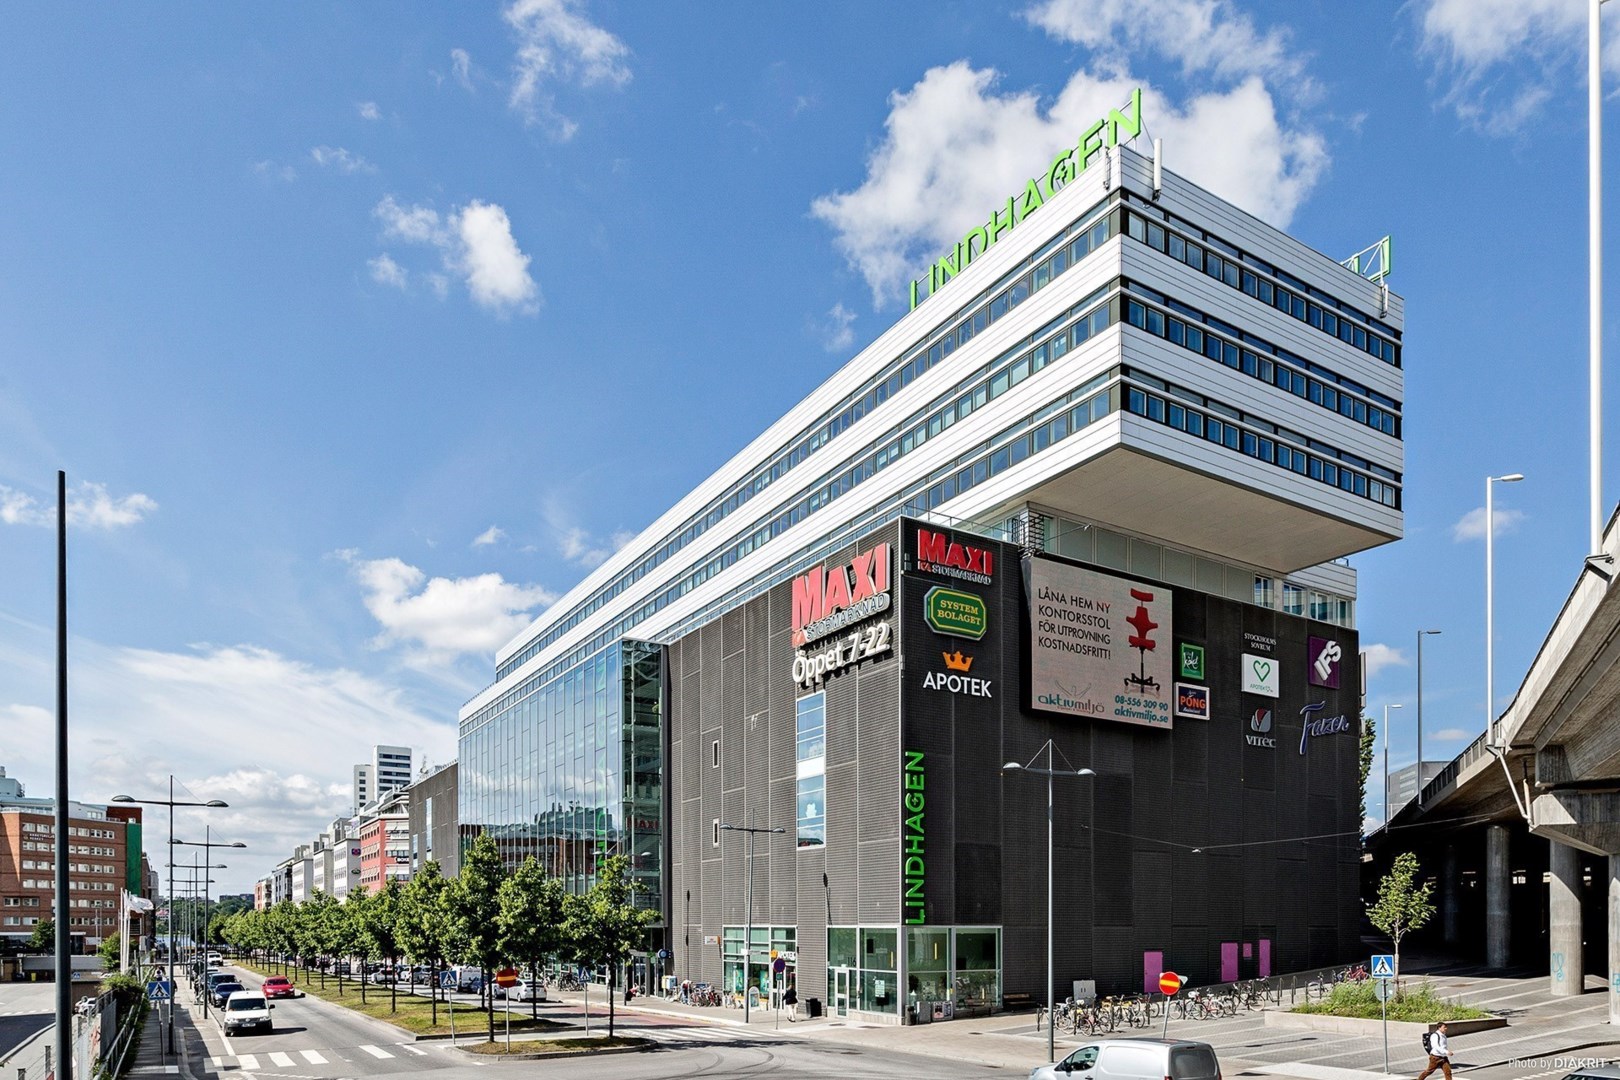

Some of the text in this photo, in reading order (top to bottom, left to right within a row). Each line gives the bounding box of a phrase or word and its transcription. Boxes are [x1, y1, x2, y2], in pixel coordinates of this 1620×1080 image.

[910, 87, 1142, 311] LINDHAGEN
[917, 528, 993, 576] MAXI
[792, 542, 891, 631] MAXI
[931, 564, 992, 586] STORMARKNAD
[940, 599, 979, 615] SYSTEM
[1038, 586, 1111, 614] LÅNA HEM NY
[806, 593, 888, 642] STORMARKNAD
[937, 609, 981, 626] BOLAGET
[1038, 604, 1111, 630] KONTORSSTOL
[1038, 619, 1111, 645] FÖR UTPROVNING
[792, 622, 890, 686] Öppet 7-22
[1038, 636, 1111, 660] KOSTNADSFRITT!
[923, 671, 992, 698] APOTEK
[1114, 694, 1169, 712] 08-556 309 90
[1114, 706, 1169, 723] aktivmiljo.se
[1180, 695, 1206, 709] PONG
[1299, 700, 1350, 756] Fazer
[905, 751, 925, 925] LINDHAGEN
